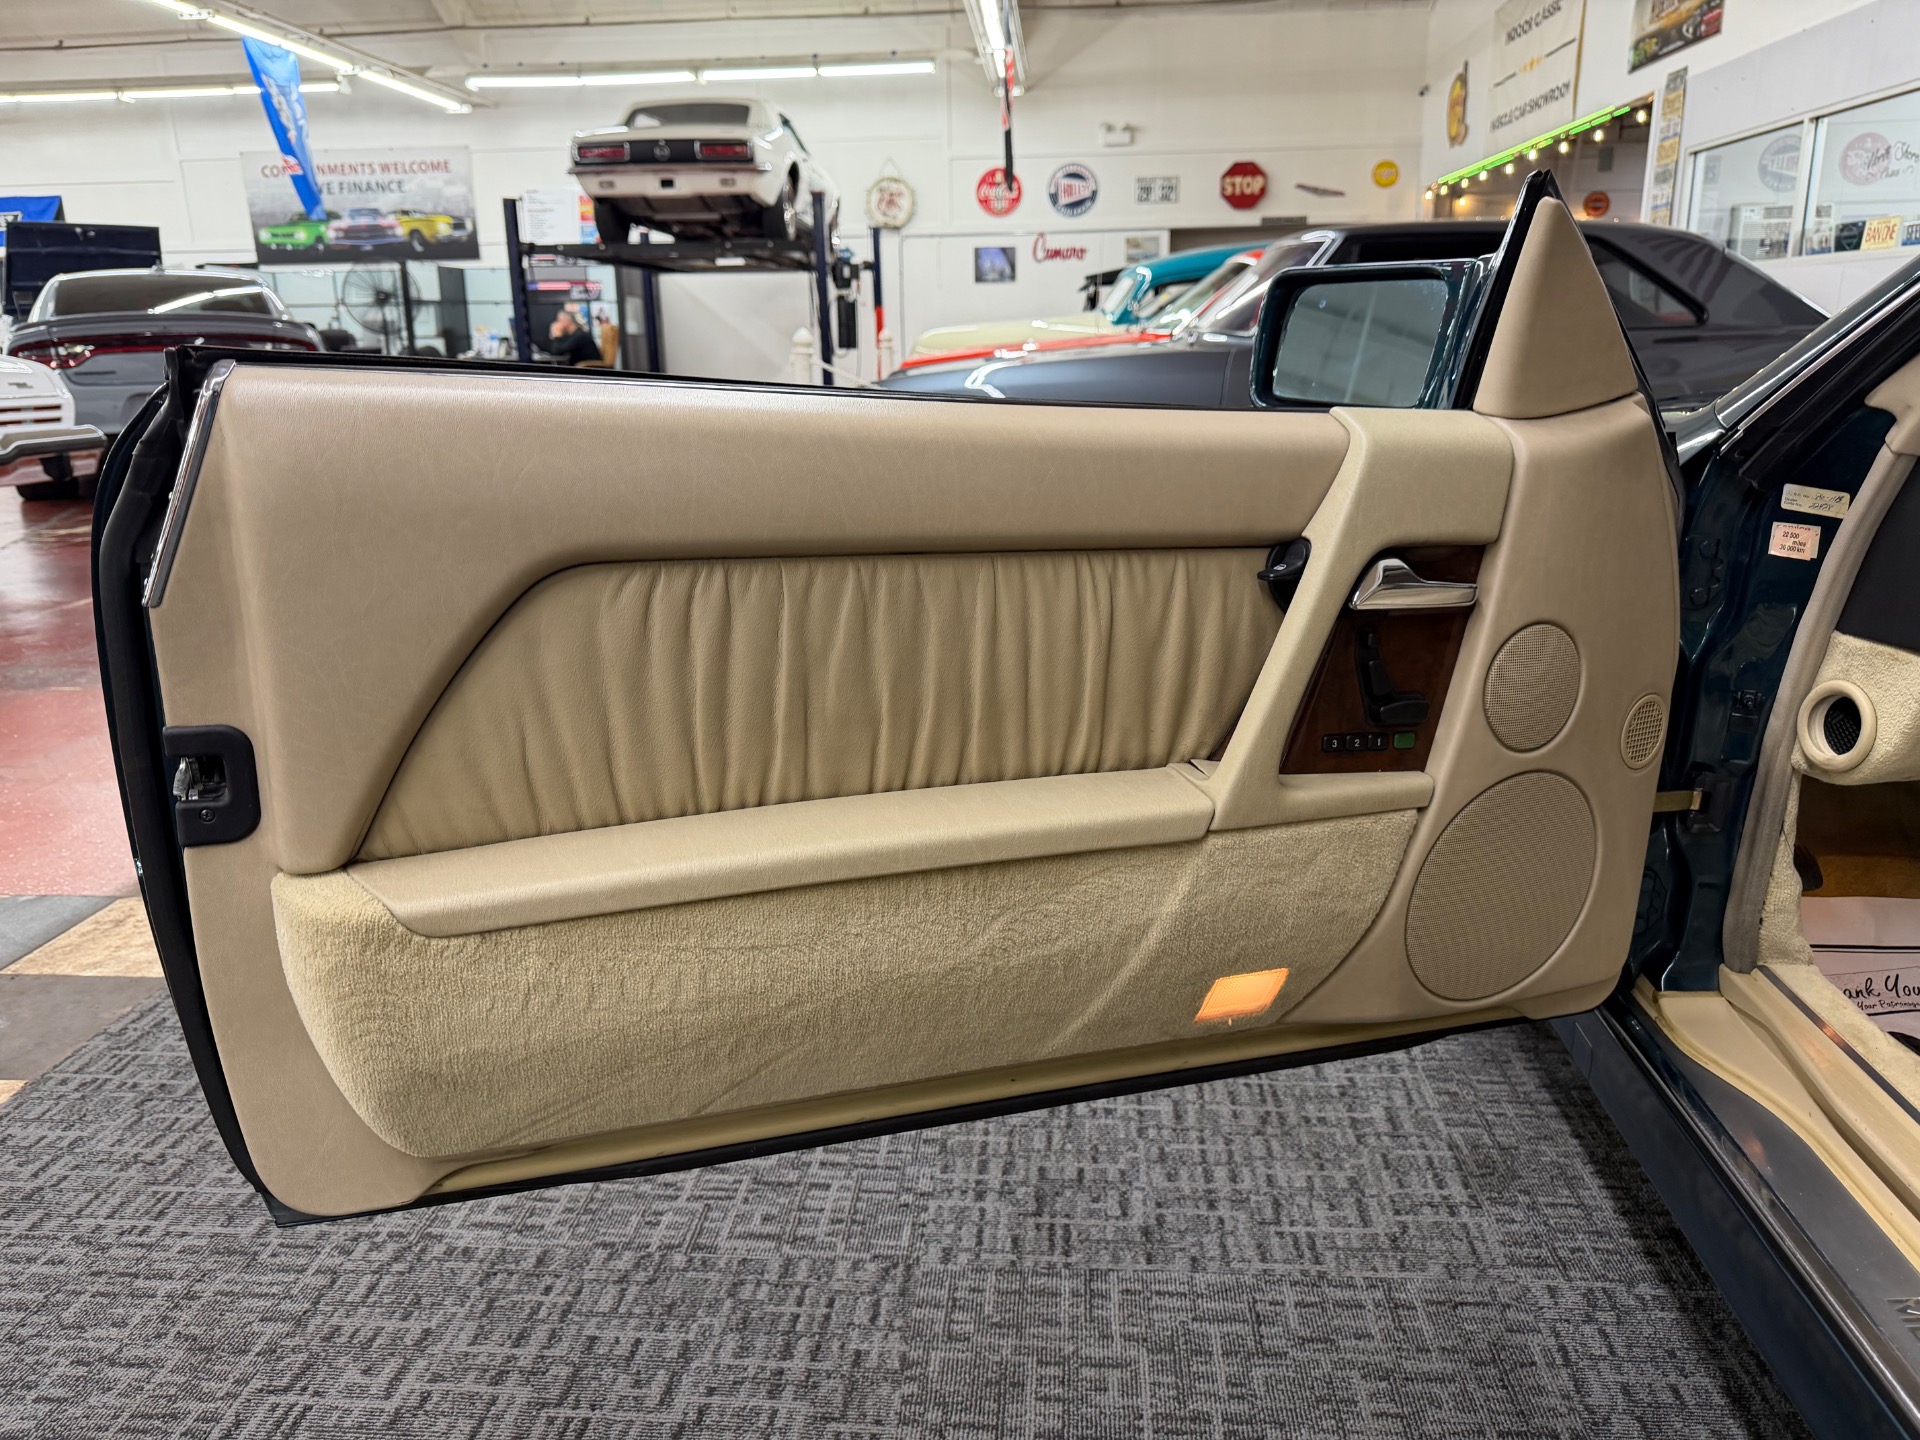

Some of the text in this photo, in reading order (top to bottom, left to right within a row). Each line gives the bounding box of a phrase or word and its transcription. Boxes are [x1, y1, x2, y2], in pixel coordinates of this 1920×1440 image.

[261, 159, 450, 178] CONMENTS WELCOME
[338, 179, 405, 194] FINANCE
[1223, 174, 1266, 196] STOP
[1033, 232, 1086, 263] Camaro
[1792, 540, 1807, 548] miles
[1331, 739, 1338, 748] 3
[1354, 739, 1360, 747] 2
[1843, 973, 1920, 999] ank You
[1857, 1001, 1877, 1011] Your
